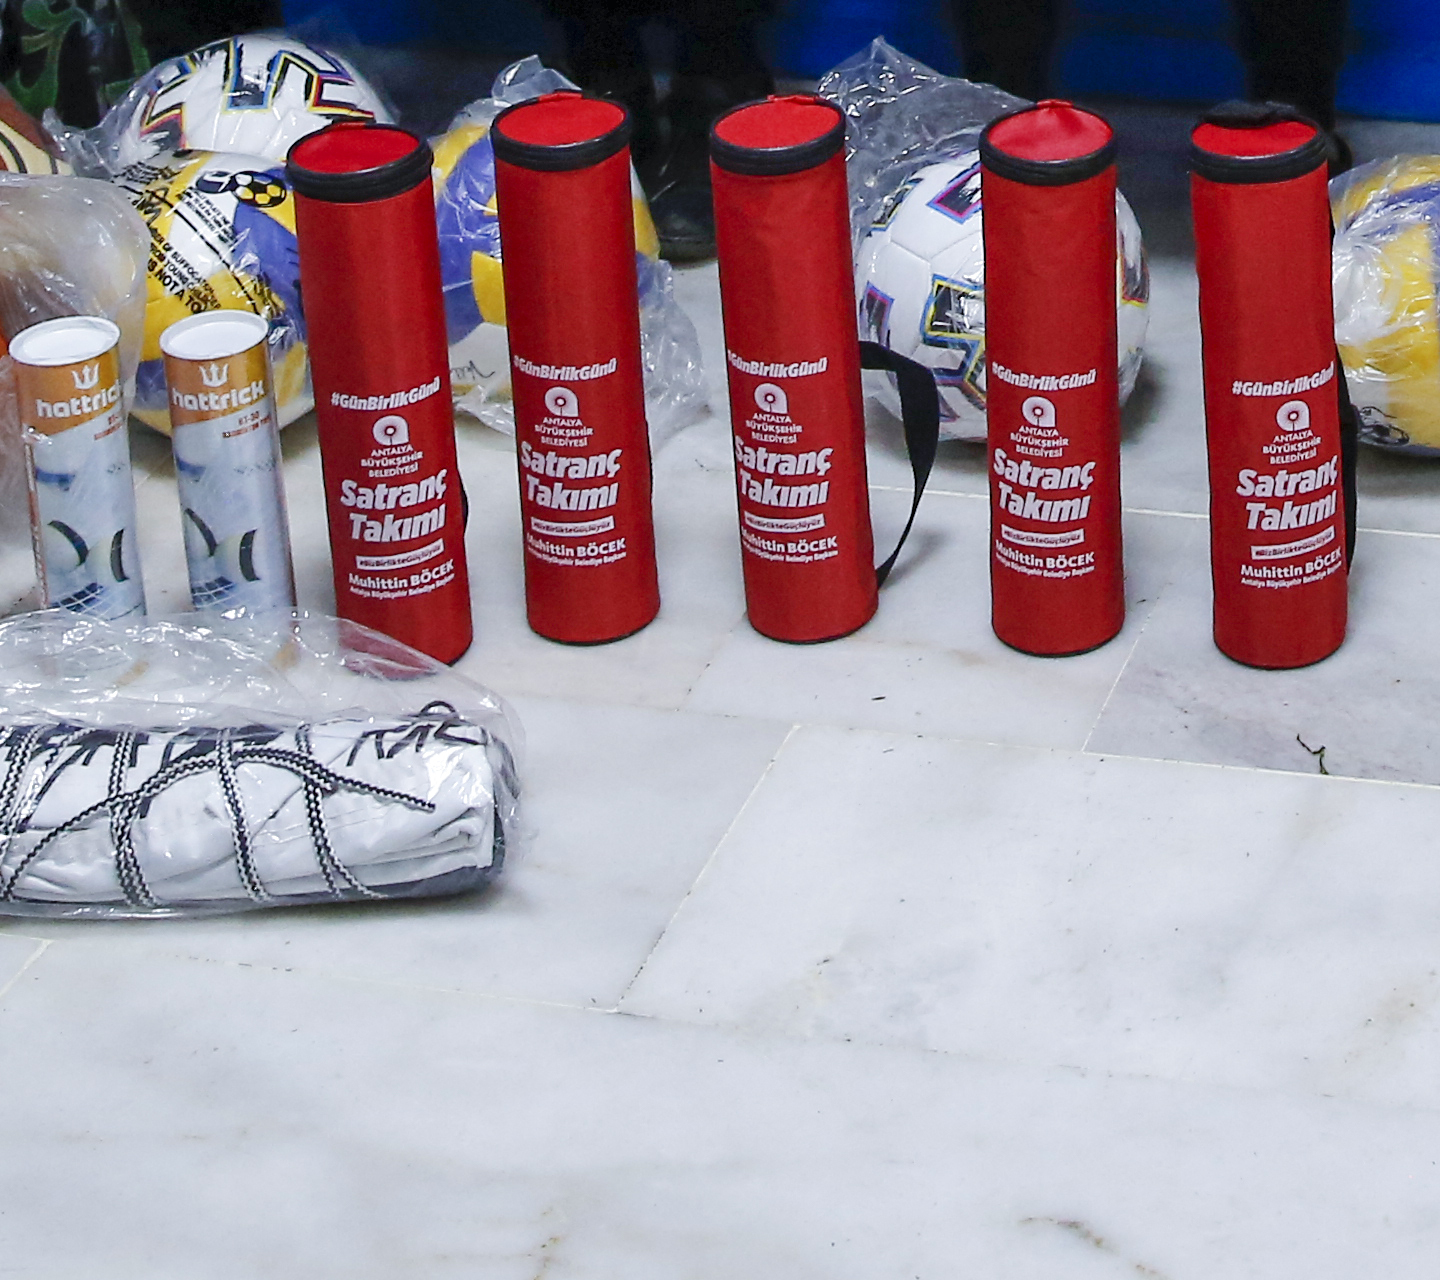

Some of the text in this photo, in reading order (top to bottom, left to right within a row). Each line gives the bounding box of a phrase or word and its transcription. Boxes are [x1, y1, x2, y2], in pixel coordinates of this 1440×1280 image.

[158, 268, 180, 291] NOT
[172, 380, 264, 412] hattrick
[331, 376, 440, 411] #GünBirlikGünü
[542, 416, 583, 428] ANTALYA
[752, 413, 792, 424] ANTALYA
[1018, 425, 1060, 438] ANTALYA
[370, 443, 414, 458] ANTALYA
[1273, 429, 1314, 444] ANTALYA
[520, 440, 623, 480] Satranç
[734, 435, 834, 477] Satranç
[993, 447, 1096, 490] Satranç
[340, 468, 447, 511] Satranç
[525, 473, 619, 511] Takımı
[739, 470, 830, 508] Takımı
[1236, 454, 1339, 498] Satranç
[997, 481, 1091, 523] Takımı
[1245, 490, 1338, 531] Takımı
[349, 504, 446, 543] Takımı
[576, 537, 627, 557] BÖCEK
[787, 535, 838, 554] BÖCEK
[995, 539, 1095, 569] Muhittin BÖCEK
[349, 559, 455, 591] Muhittin BÖCEK
[1240, 546, 1341, 580] Muhittin BÖCEK
